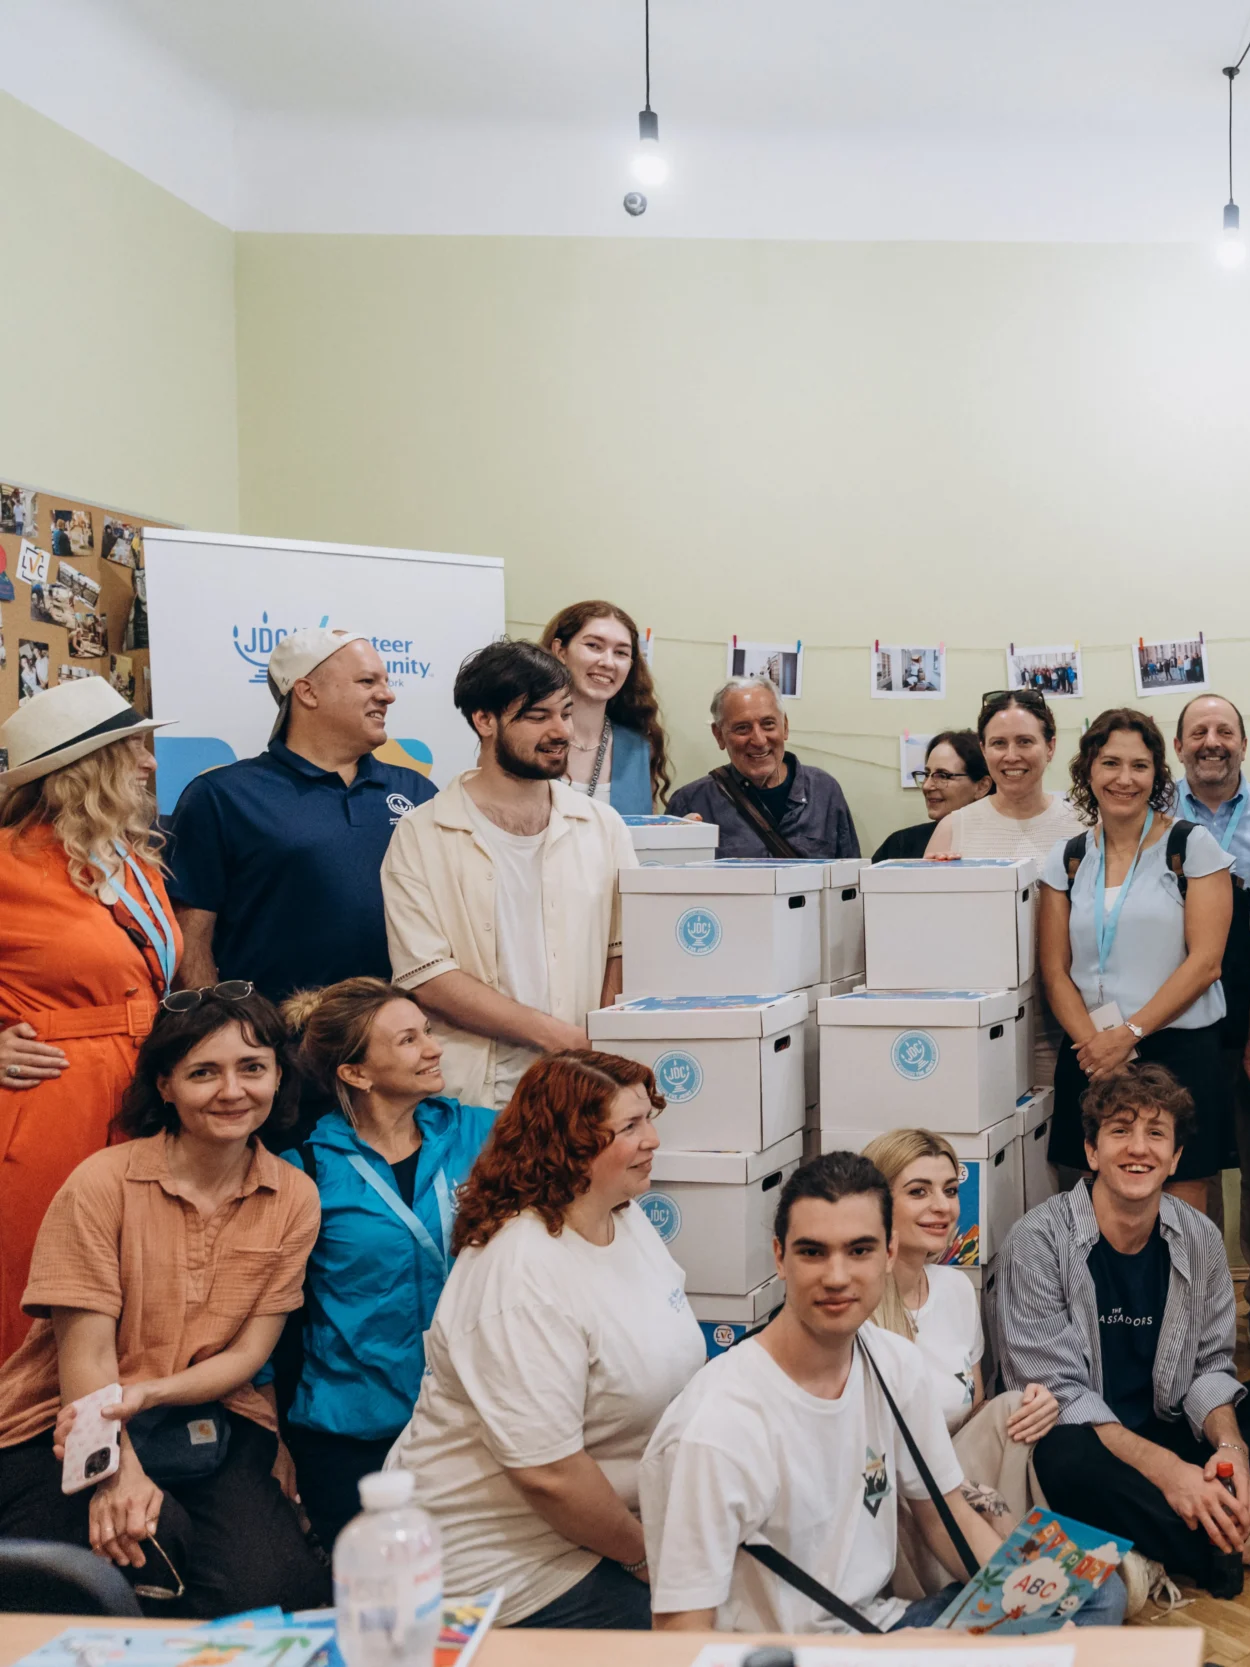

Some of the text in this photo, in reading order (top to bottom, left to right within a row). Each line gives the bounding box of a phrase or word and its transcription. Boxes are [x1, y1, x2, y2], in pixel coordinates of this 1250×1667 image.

[371, 637, 414, 653] teer
[690, 922, 707, 934] JDC
[905, 1043, 922, 1061] JDC
[668, 1066, 687, 1080] JDC
[1099, 1314, 1153, 1326] ASSADORS
[715, 1328, 732, 1340] LVC
[1013, 1574, 1057, 1599] ABC
